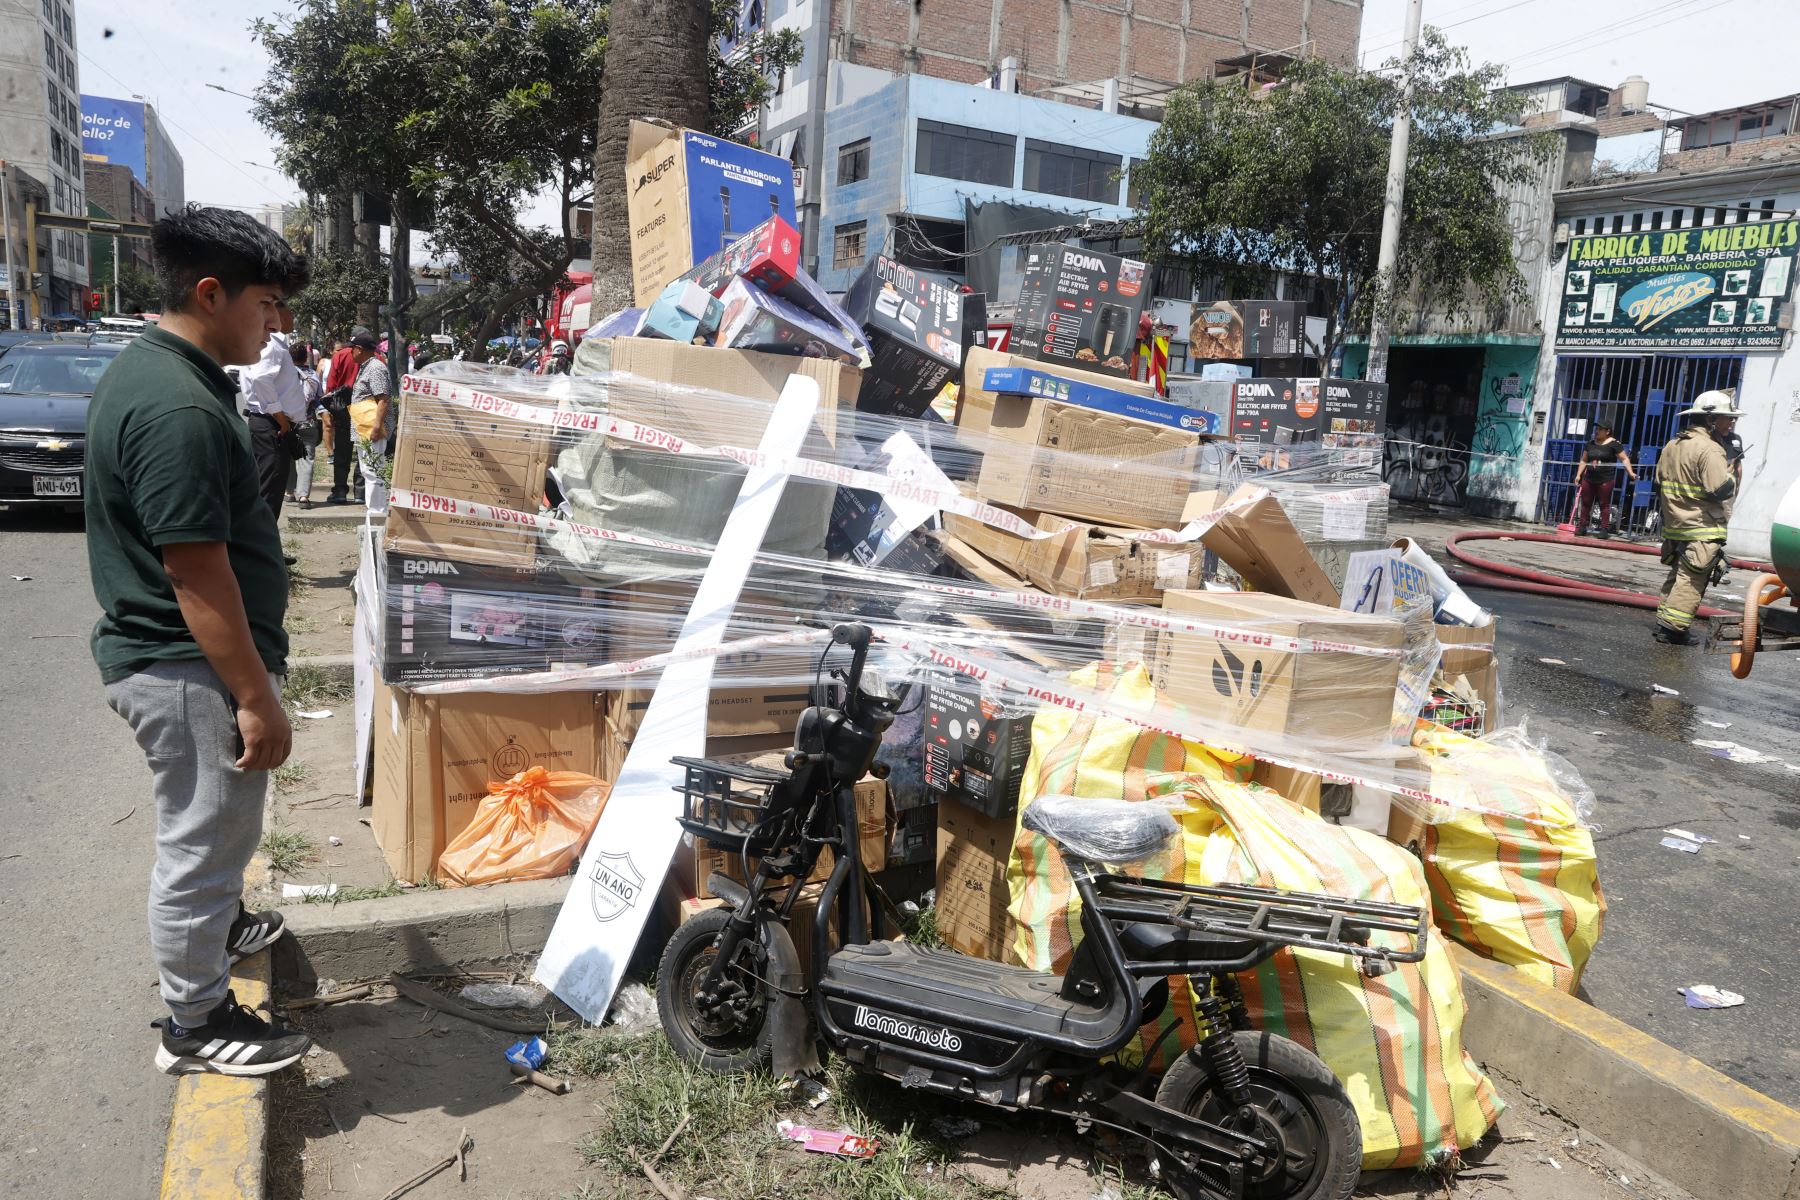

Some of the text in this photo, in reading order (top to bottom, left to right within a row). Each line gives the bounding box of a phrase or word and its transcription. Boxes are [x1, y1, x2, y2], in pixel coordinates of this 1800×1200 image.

[114, 117, 131, 129] de
[82, 129, 115, 141] ello?
[646, 155, 676, 184] SUPER
[700, 155, 742, 173] PARLANTE
[743, 168, 776, 183] ANDROID
[637, 213, 667, 240] FEATURES
[1570, 221, 1799, 260] FABRICA DE MUEBLES
[1063, 251, 1107, 273] BOMA
[1578, 259, 1605, 268] PARA
[1609, 255, 1677, 266] PELUQUERIA
[1756, 247, 1782, 257] SPA
[1595, 266, 1633, 275] CALIDAD
[1695, 259, 1757, 270] COMODIDAD
[1060, 272, 1088, 283] ELECTRIC
[1070, 281, 1090, 291] FRYER
[1647, 274, 1686, 288] Muebles
[1057, 286, 1079, 295] BM-589
[946, 290, 959, 322] BOMA
[1674, 326, 1777, 334] WWW.MUEBLESVICTOR.COM
[1556, 338, 1565, 346] AV.
[1565, 338, 1585, 346] MANCO
[1586, 338, 1605, 346] CAPAC
[1619, 338, 1627, 346] LA
[1628, 338, 1655, 346] VICTORIA
[1679, 338, 1690, 346] 425
[1691, 338, 1705, 346] 0692
[923, 366, 949, 391] BOMA
[1237, 383, 1276, 397] BOMA
[1326, 386, 1351, 398] BOMA
[403, 375, 440, 396] FRAG
[472, 392, 520, 418] FRAGIL
[552, 412, 599, 430] FRAGIL
[633, 425, 683, 453] FRAGIL
[887, 478, 941, 507] FRAGIL
[971, 501, 1021, 532] FRAGIL
[36, 481, 78, 493] ANU-491
[410, 493, 457, 513] FRAGIL
[488, 507, 537, 525] FRAGIL
[570, 523, 618, 539] FRAGIL
[403, 560, 460, 575] BOMA
[928, 648, 989, 681] FRAGIL
[930, 685, 976, 707] MULTI-FUNCTIONAL
[930, 693, 968, 713] AIR FRYER OVEN
[448, 793, 467, 803] light
[595, 867, 633, 900] UN AÑO
[854, 1005, 962, 1052] llamamoto
